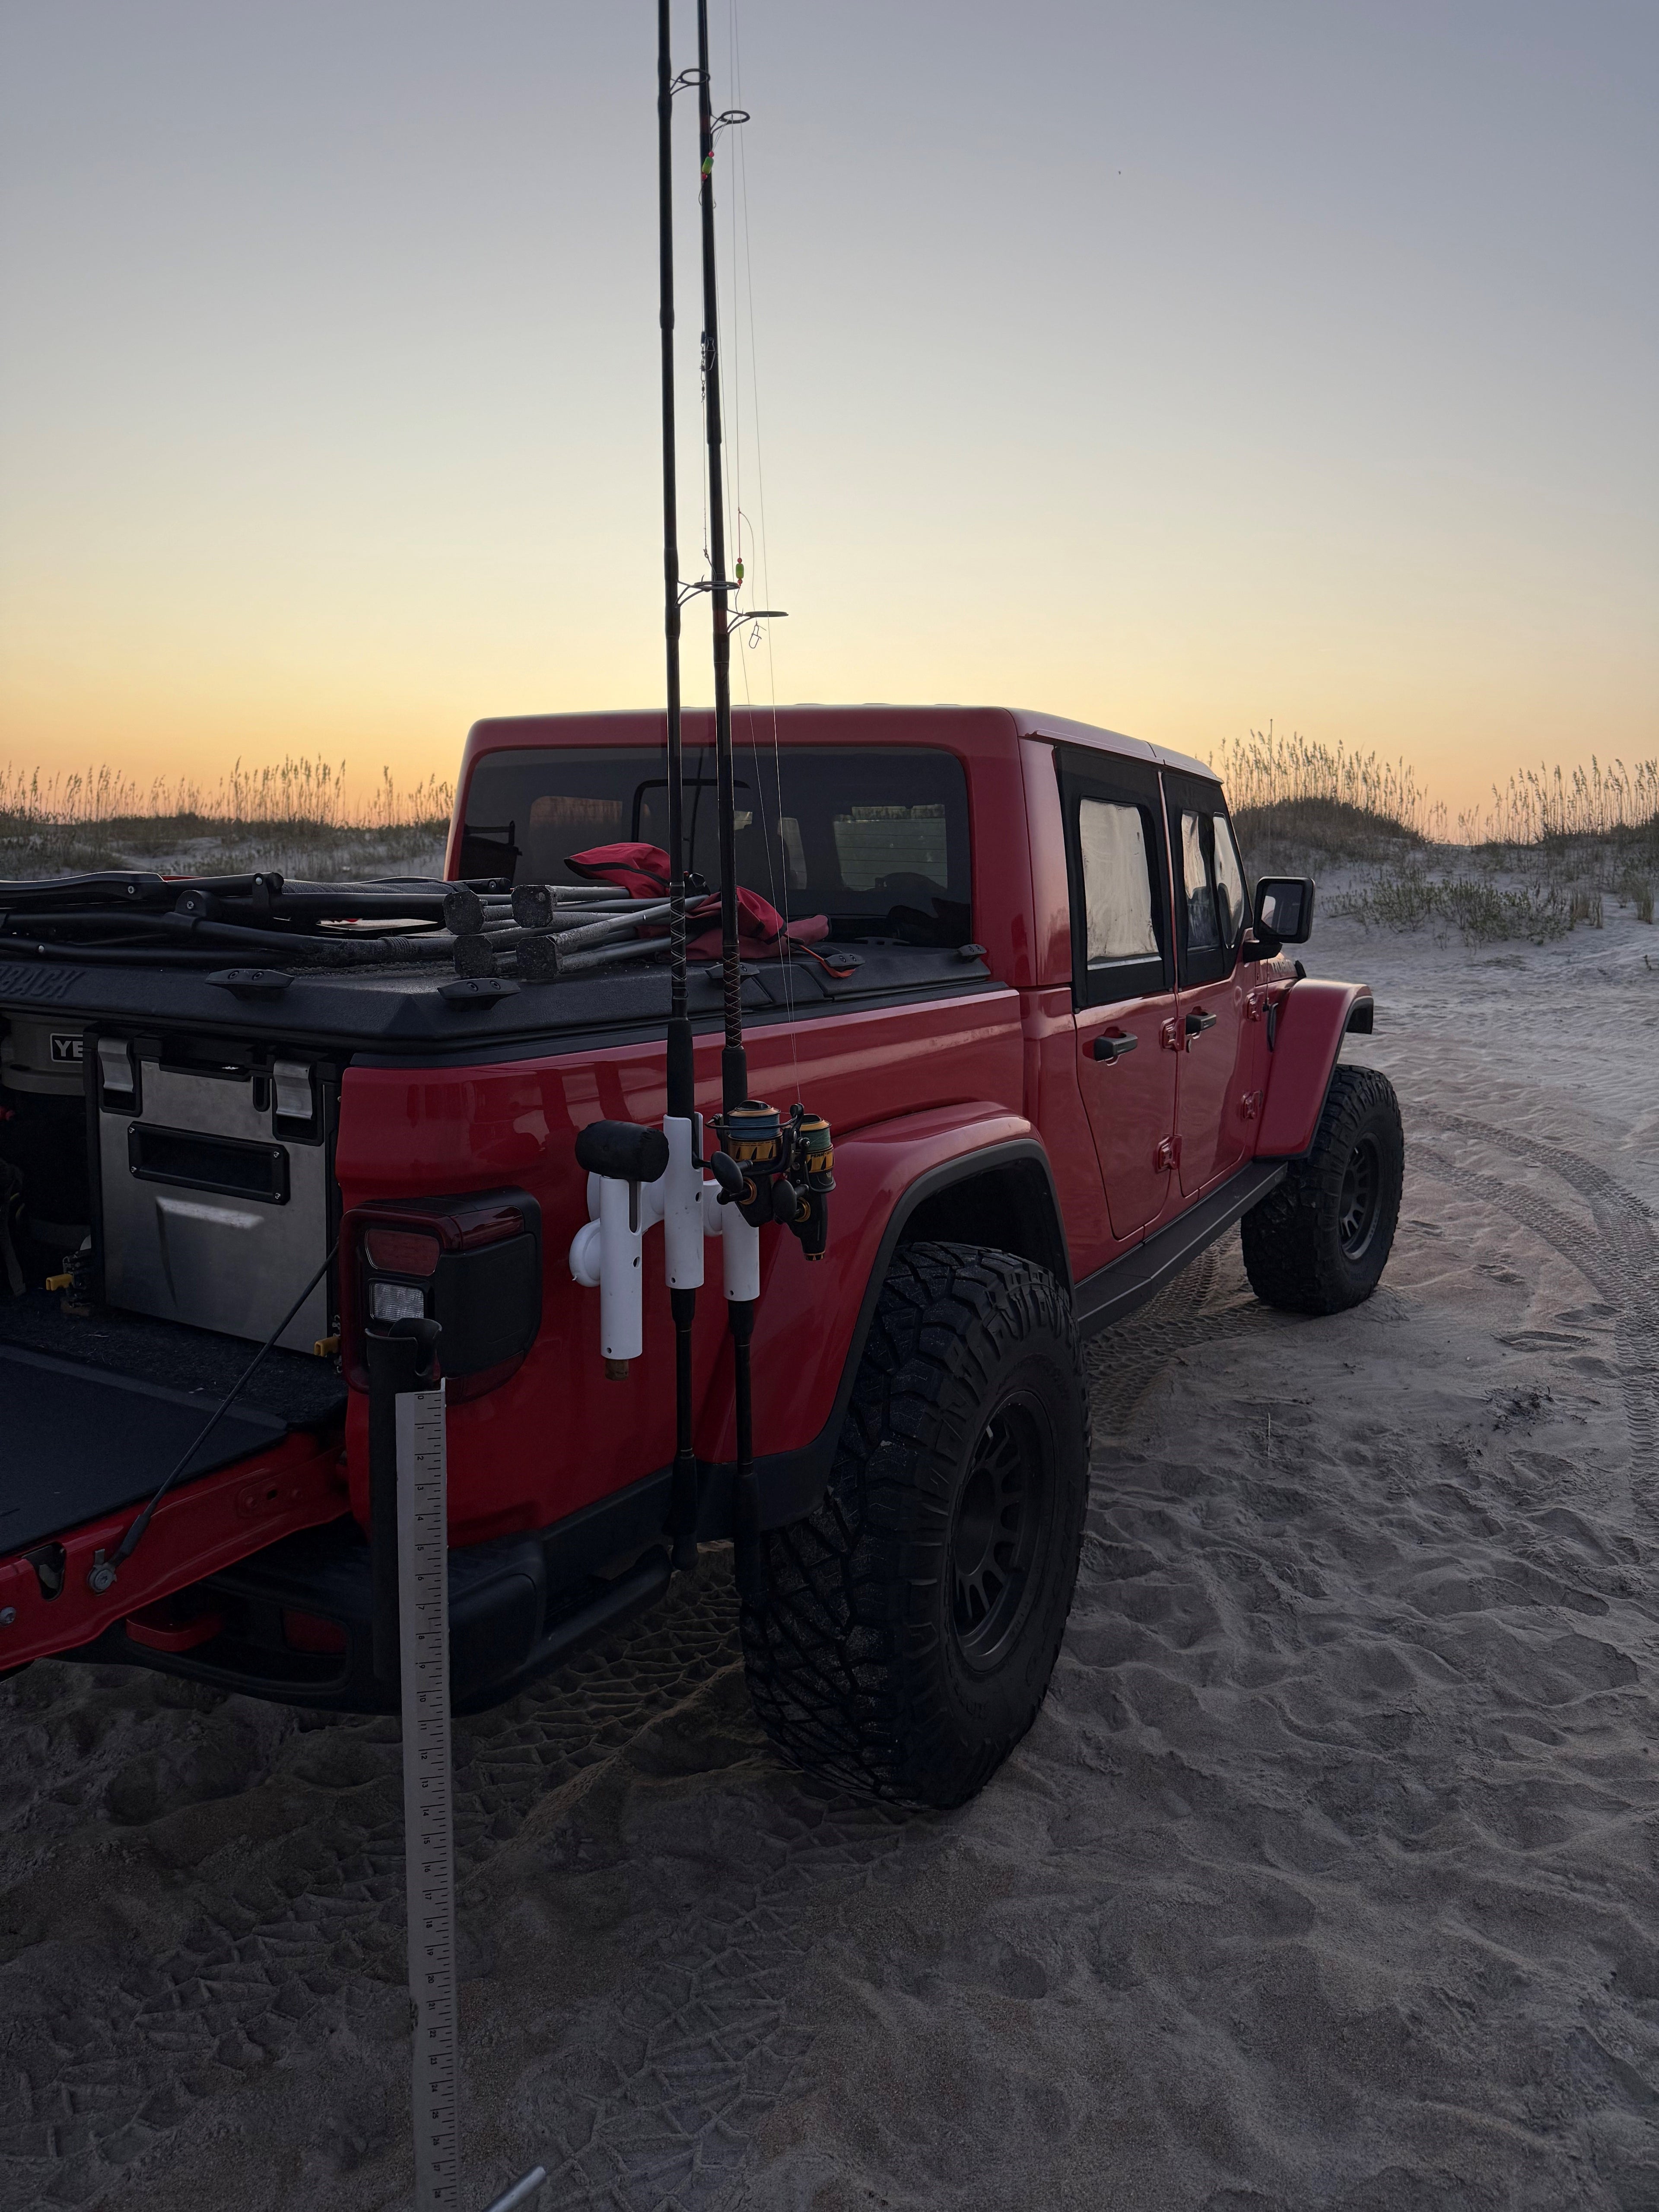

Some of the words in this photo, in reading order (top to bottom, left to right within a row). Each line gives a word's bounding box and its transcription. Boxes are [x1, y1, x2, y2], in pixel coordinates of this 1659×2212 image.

[0, 965, 86, 998] BACK
[419, 1694, 426, 1703] 10
[420, 1752, 428, 1760] 12
[421, 1780, 429, 1788] 13
[426, 1920, 433, 1929] 18
[427, 1975, 435, 1984] 20
[429, 2030, 437, 2038] 22
[431, 2084, 438, 2093] 24
